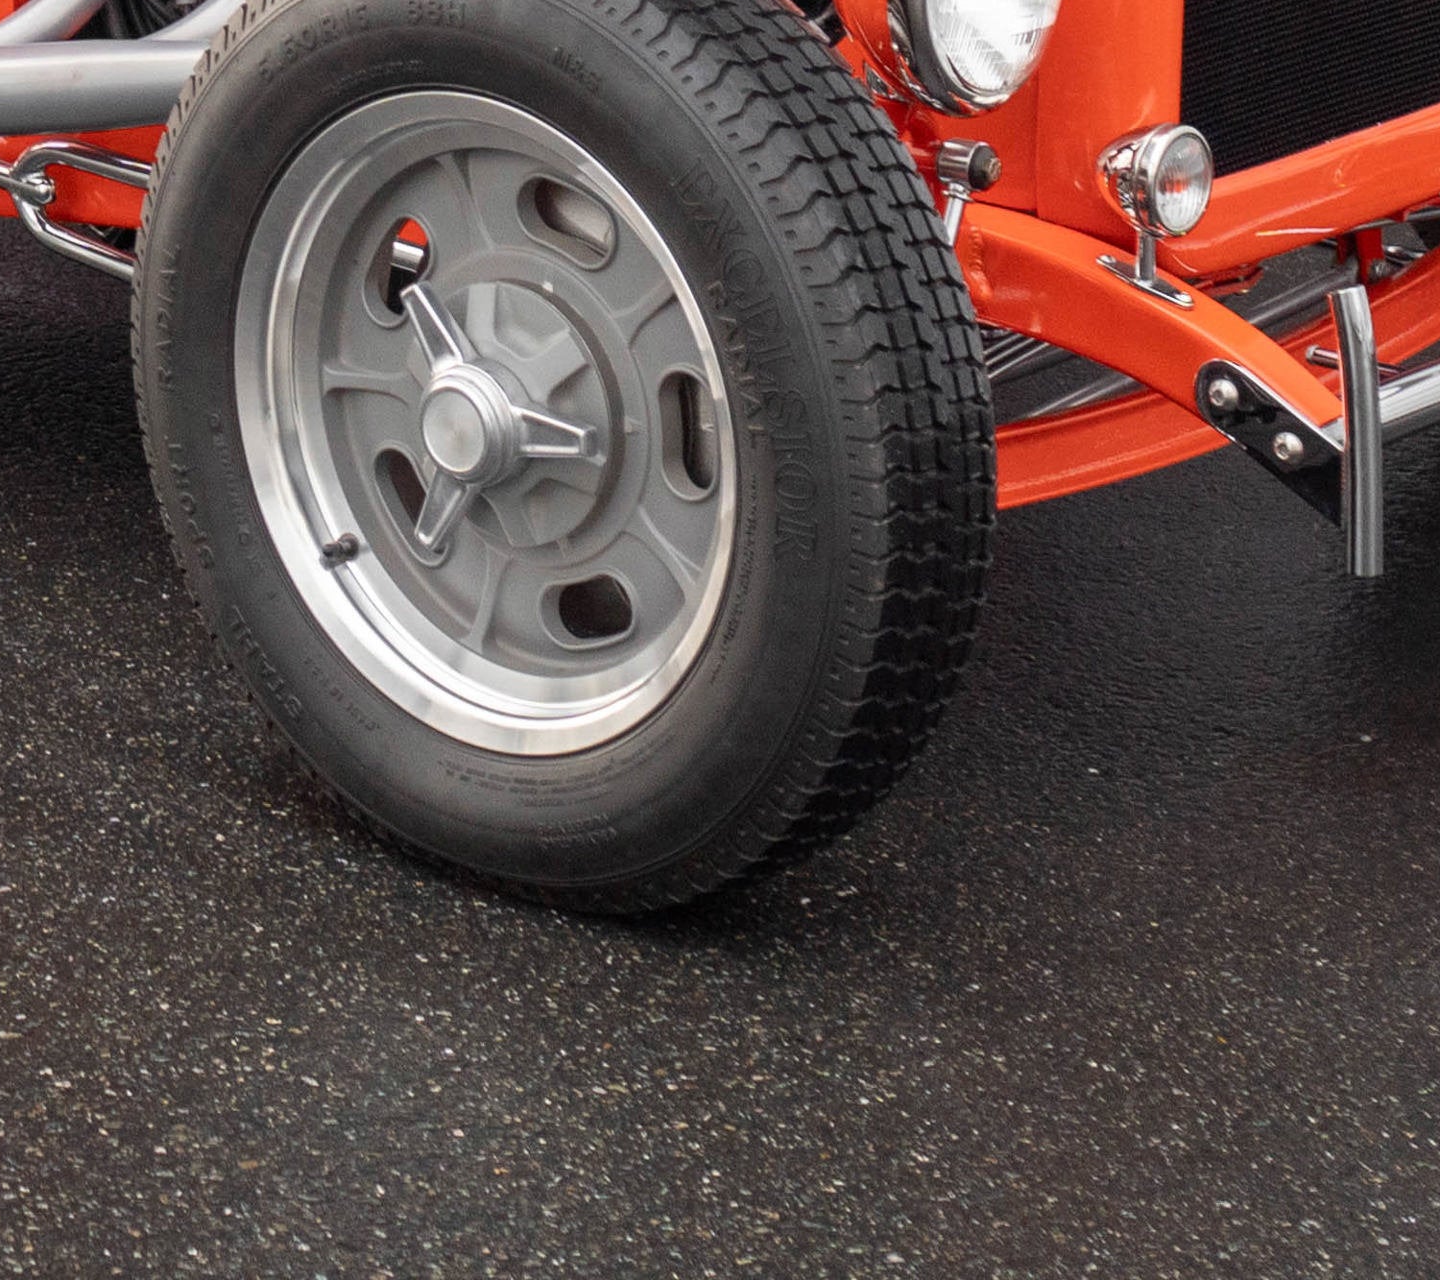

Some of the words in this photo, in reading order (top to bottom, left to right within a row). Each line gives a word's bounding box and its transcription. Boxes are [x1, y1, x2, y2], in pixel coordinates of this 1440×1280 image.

[154, 244, 184, 392] RADIAL
[671, 156, 821, 563] EXCELSIOR
[708, 279, 766, 449] RADIAL
[161, 433, 215, 571] SPORT
